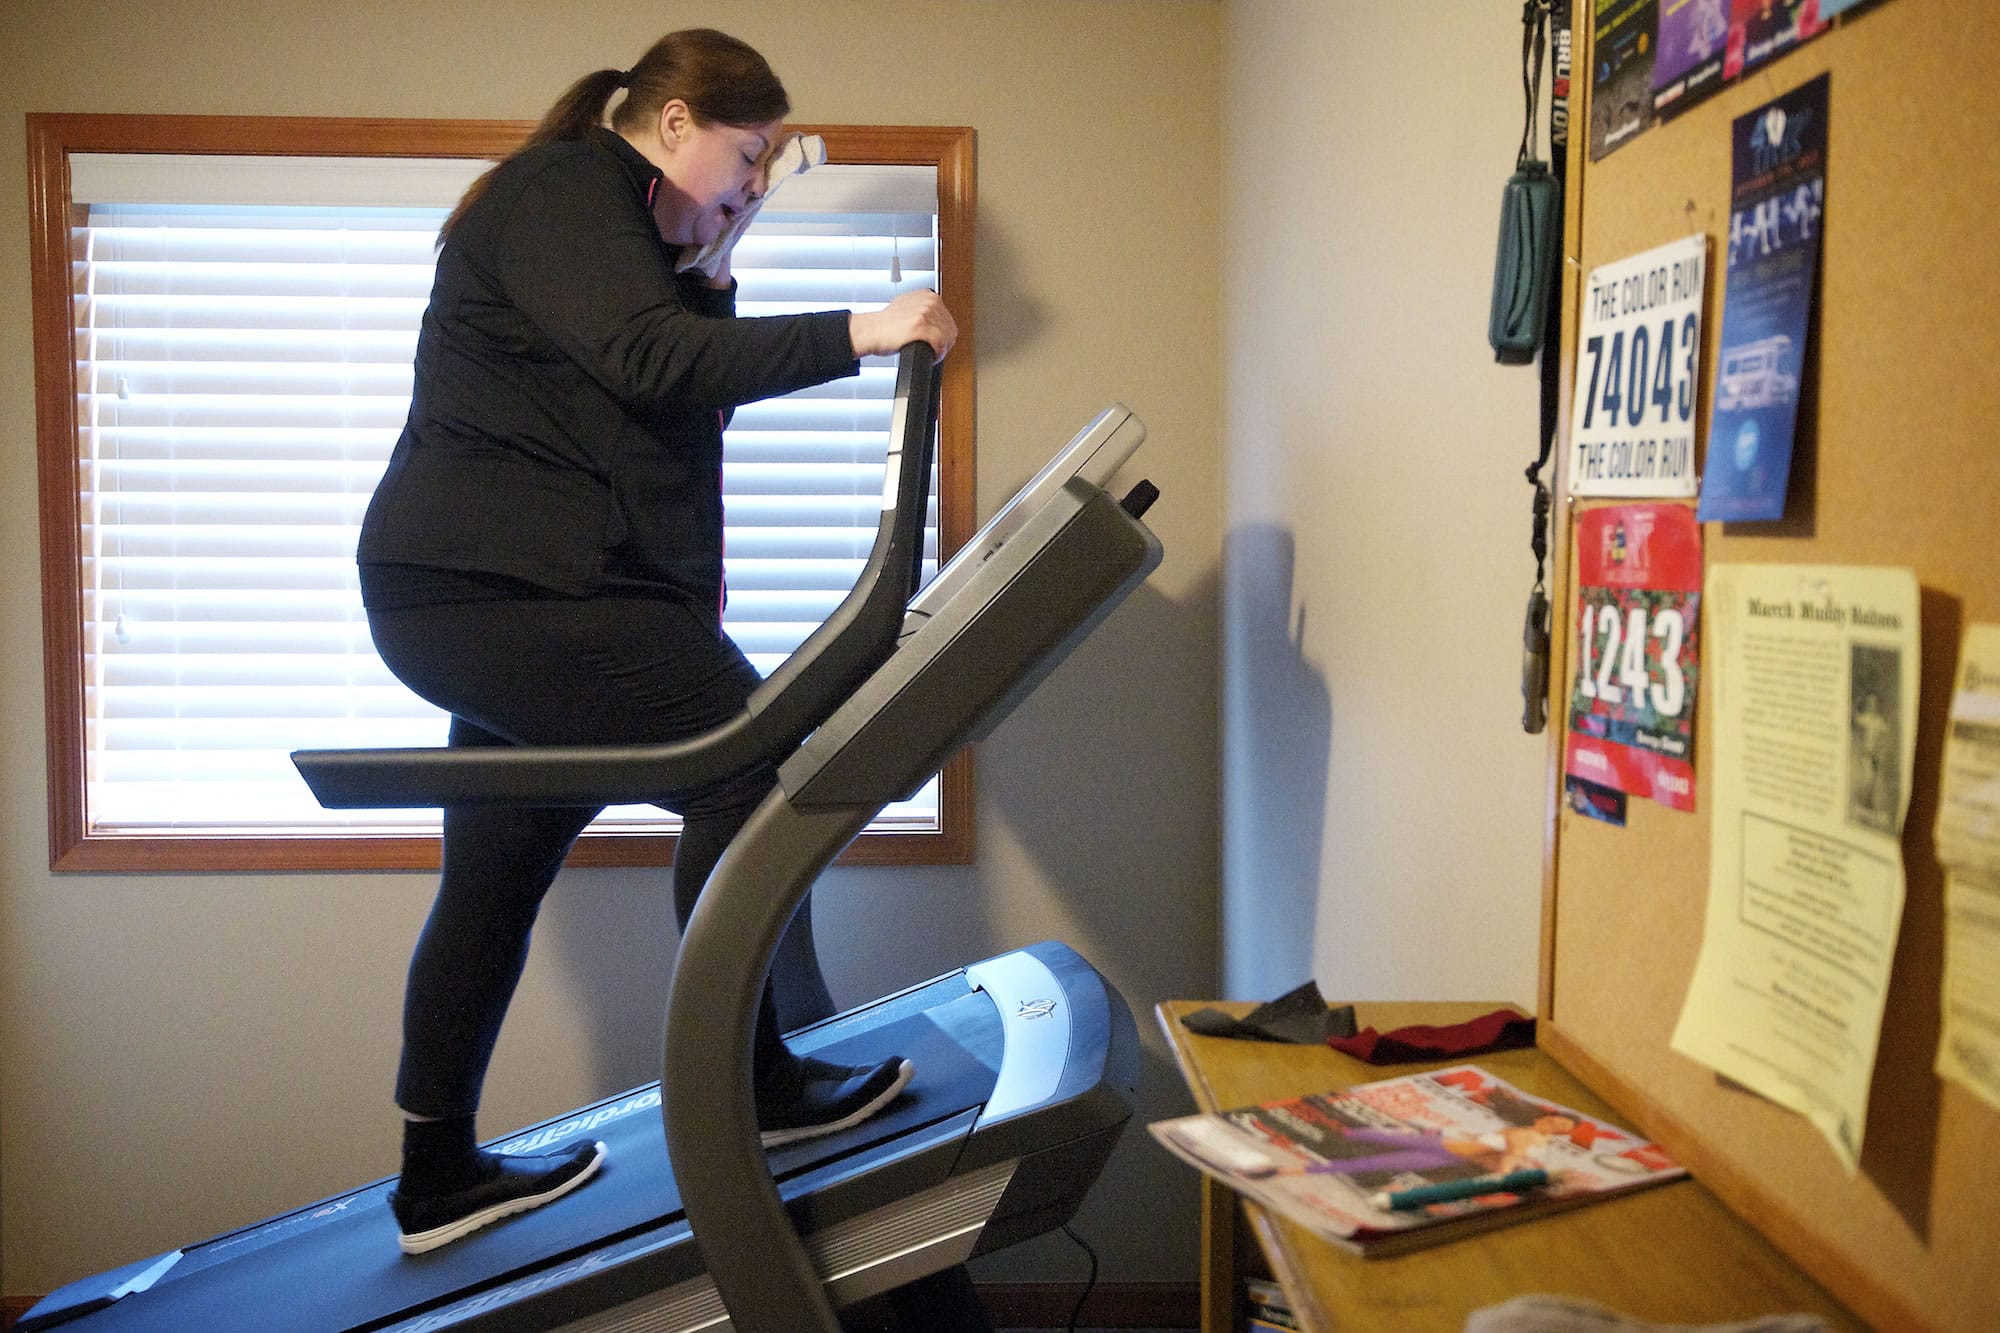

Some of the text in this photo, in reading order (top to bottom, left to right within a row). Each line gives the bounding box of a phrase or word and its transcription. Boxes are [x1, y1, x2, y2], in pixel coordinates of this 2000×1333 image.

[1551, 29, 1572, 146] BRUNTON
[1592, 255, 1699, 323] THE COLOR RUN
[1583, 311, 1697, 429] 74043
[1579, 436, 1688, 480] THE COLOR RUN
[1581, 604, 1685, 717] 1243
